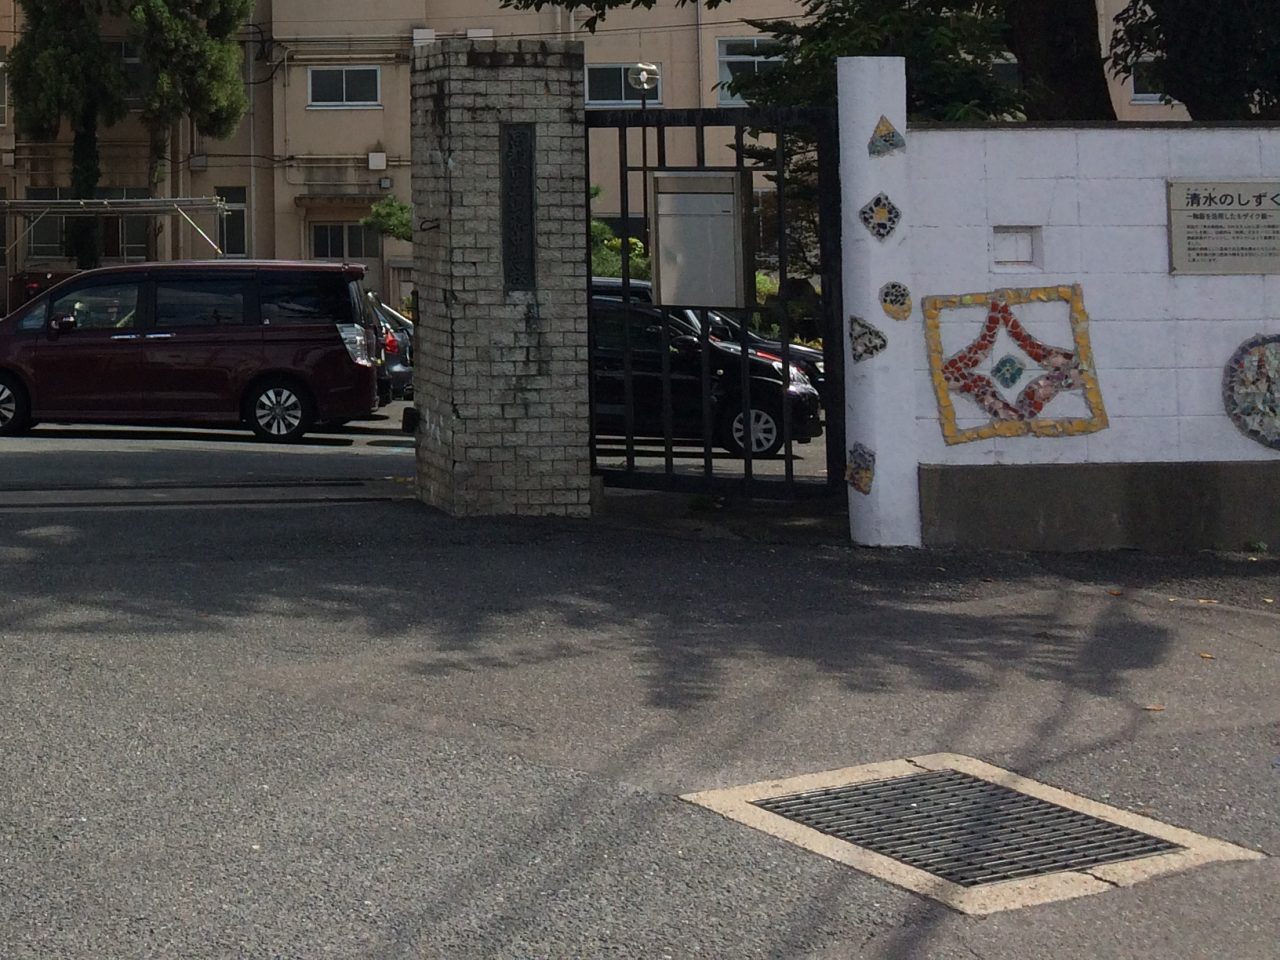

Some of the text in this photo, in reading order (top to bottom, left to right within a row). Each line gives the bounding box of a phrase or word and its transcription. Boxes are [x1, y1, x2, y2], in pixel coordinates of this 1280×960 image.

[1185, 192, 1280, 207] 清水のしずく
